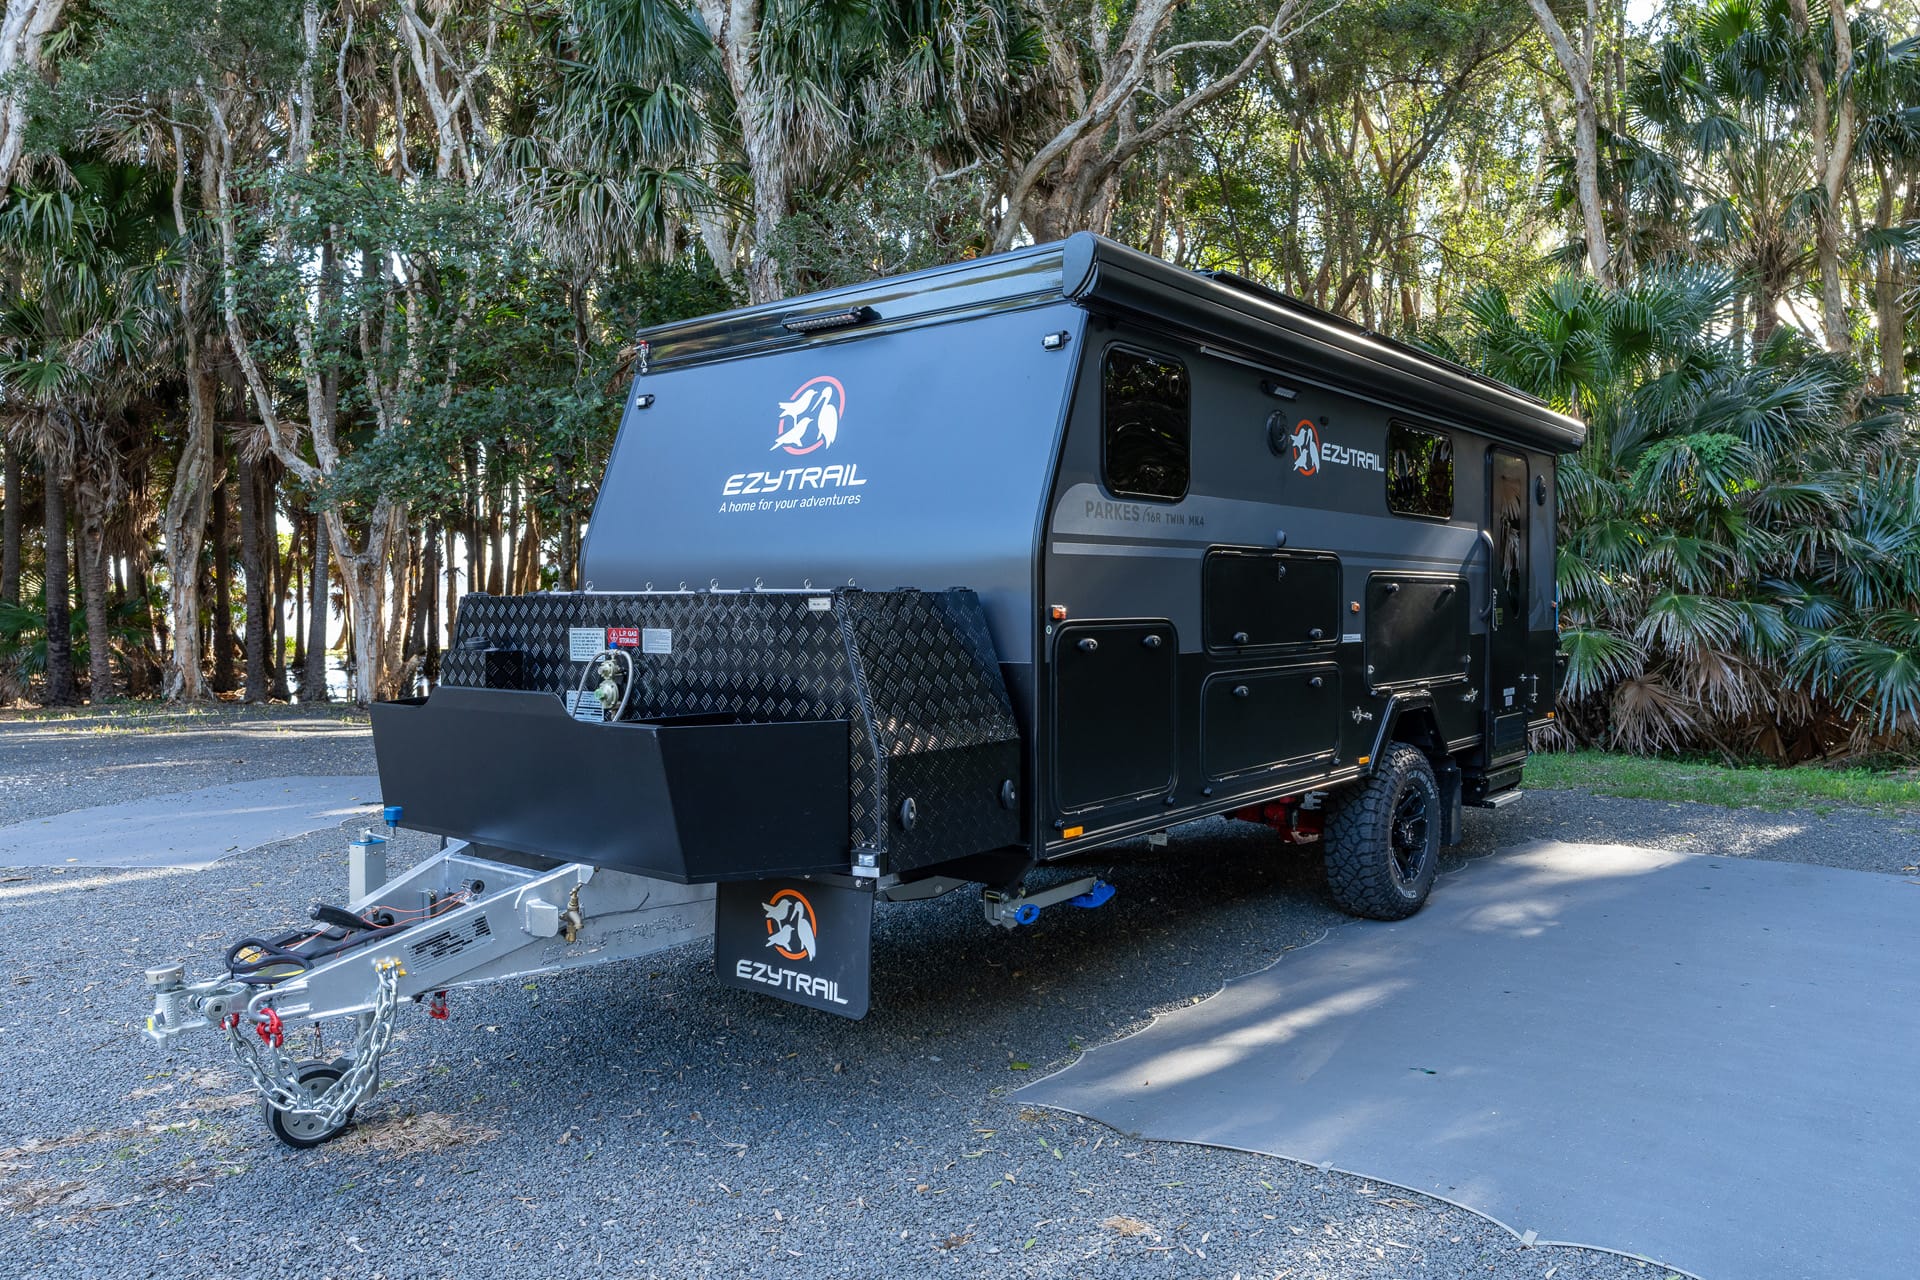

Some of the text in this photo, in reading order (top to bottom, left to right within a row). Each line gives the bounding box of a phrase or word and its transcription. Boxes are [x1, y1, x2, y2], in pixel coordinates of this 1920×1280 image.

[1321, 442, 1385, 473] EZYTRAIL
[722, 463, 868, 496] EZYTRAIL
[718, 494, 862, 514] A home for your adventures
[1085, 500, 1140, 522] PARKES
[1165, 513, 1185, 526] TWIN
[736, 958, 849, 1005] EZYTRAIL
